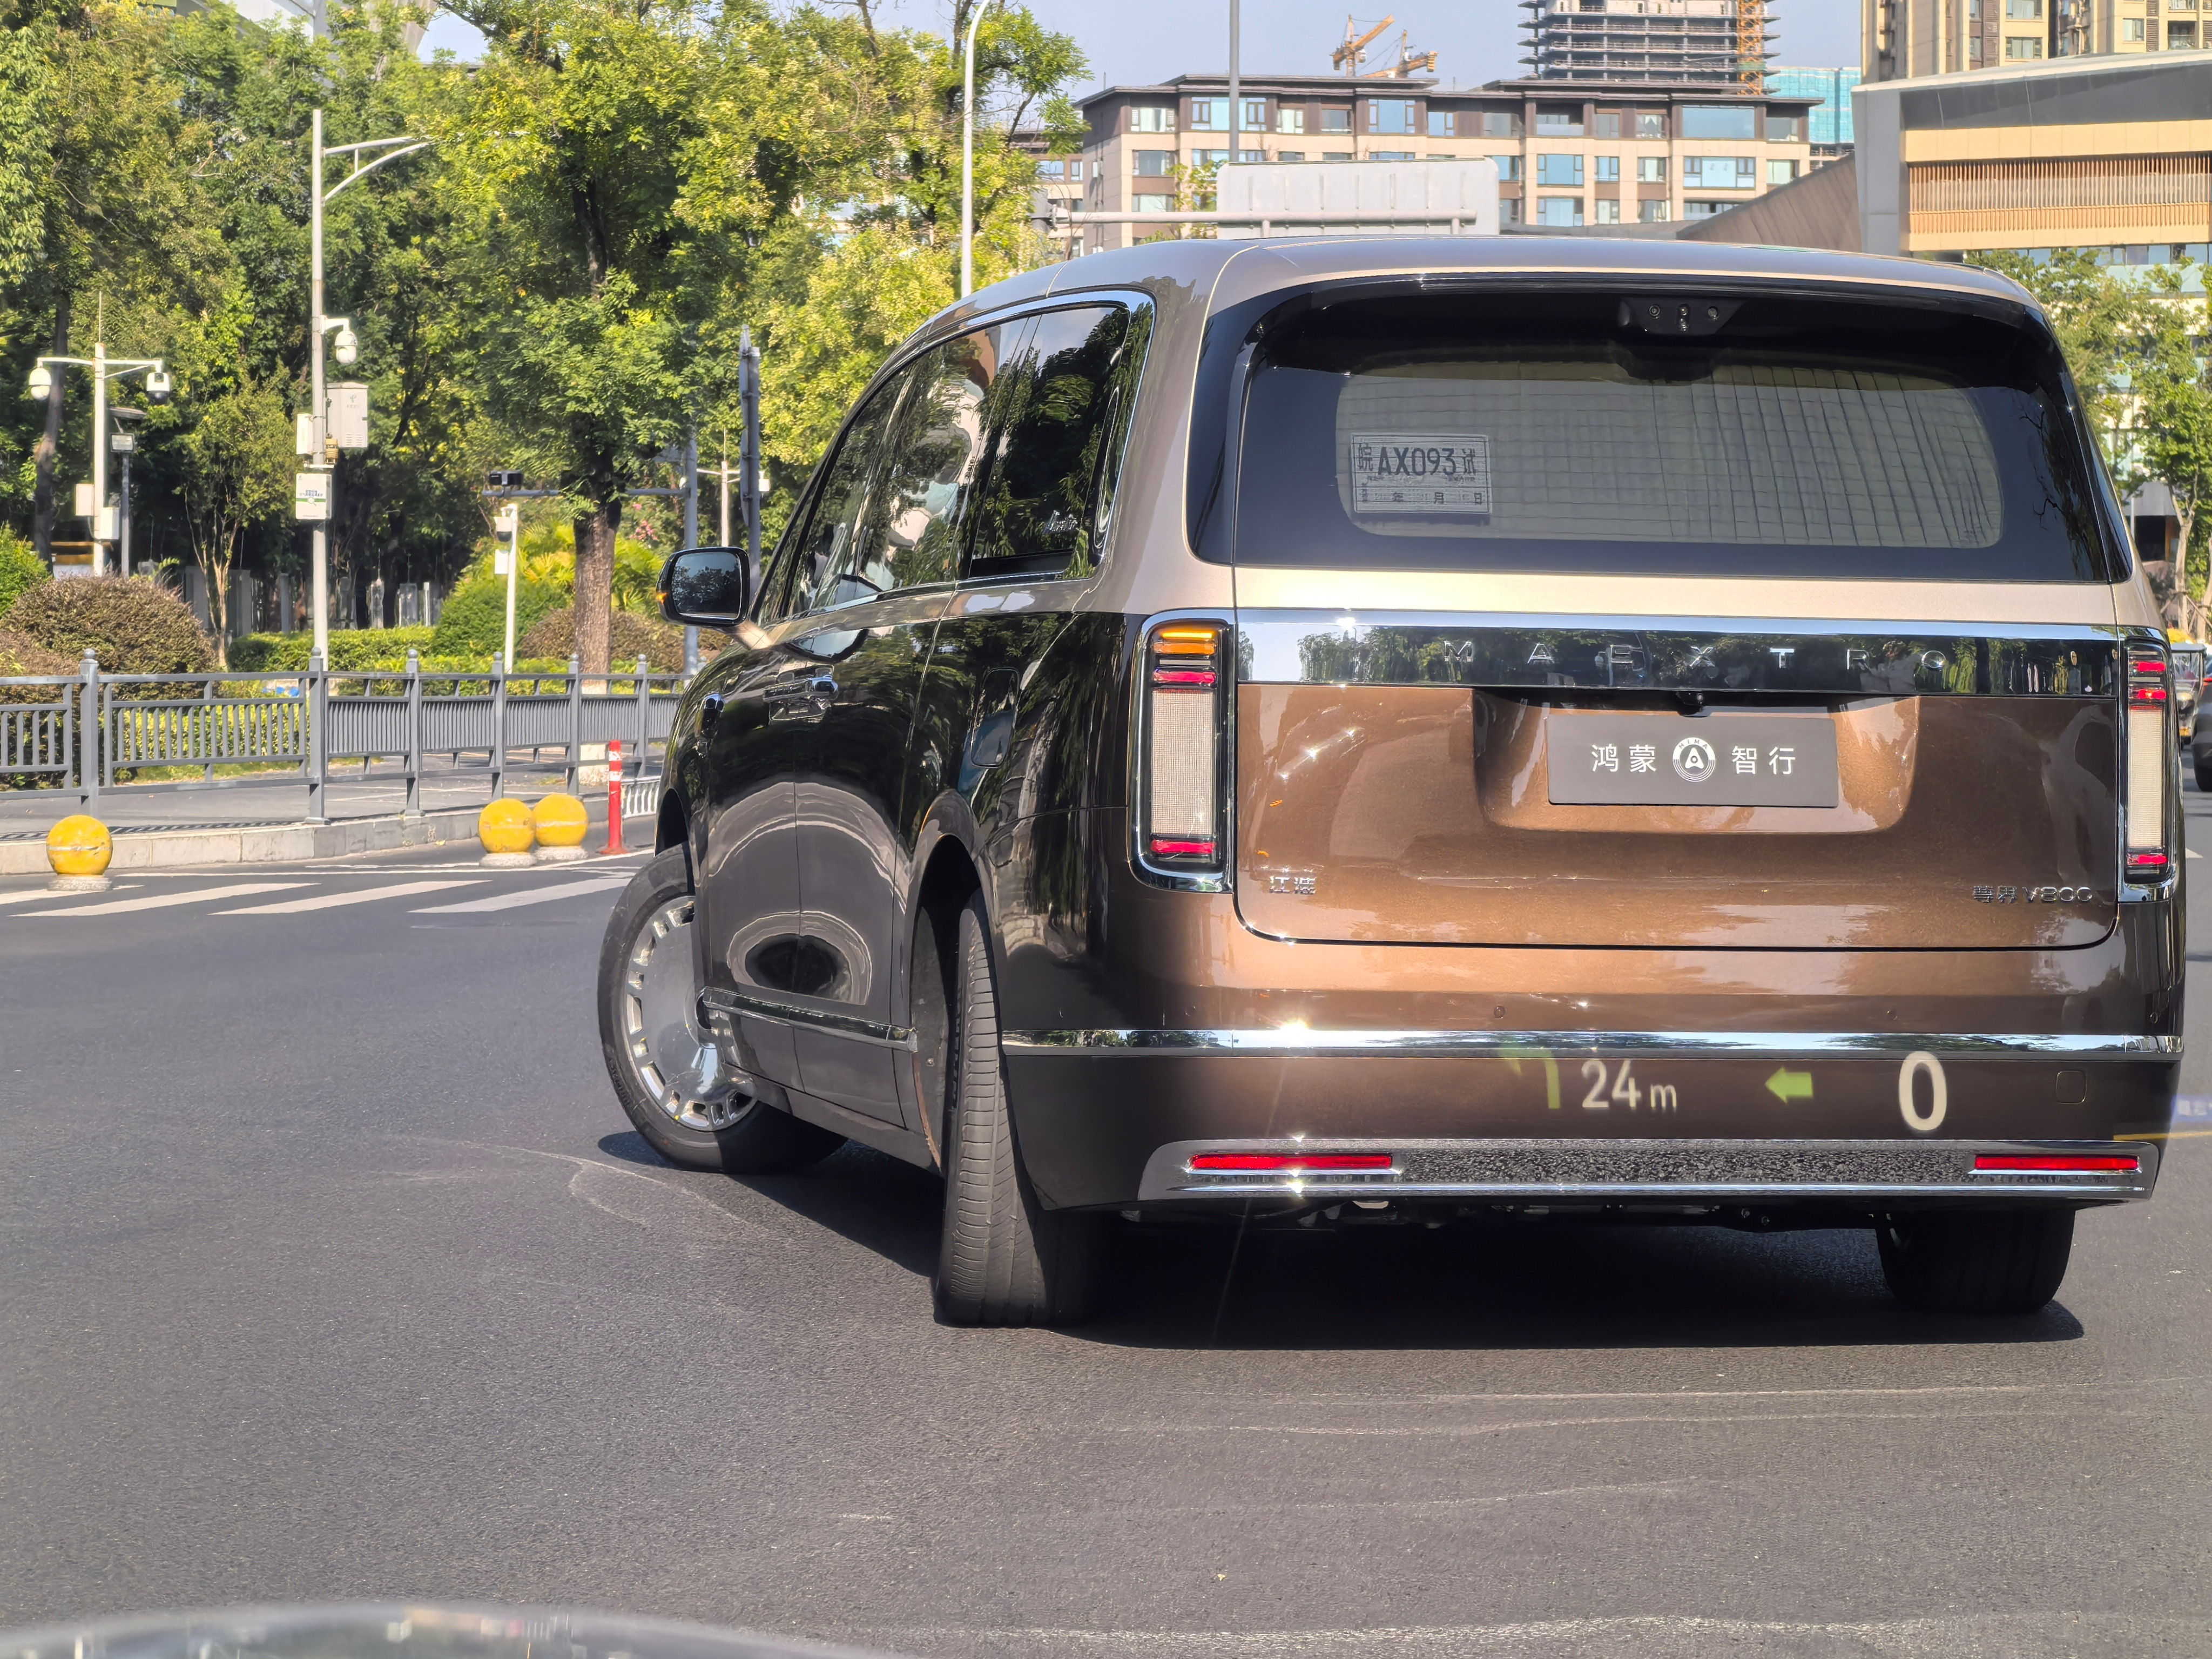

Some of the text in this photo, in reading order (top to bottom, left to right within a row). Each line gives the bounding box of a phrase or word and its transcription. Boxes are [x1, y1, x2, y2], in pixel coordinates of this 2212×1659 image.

[1444, 641, 1946, 670] MAEXTRO
[1591, 744, 1796, 775] 鸿蒙 智行
[1898, 1051, 1947, 1131] 0
